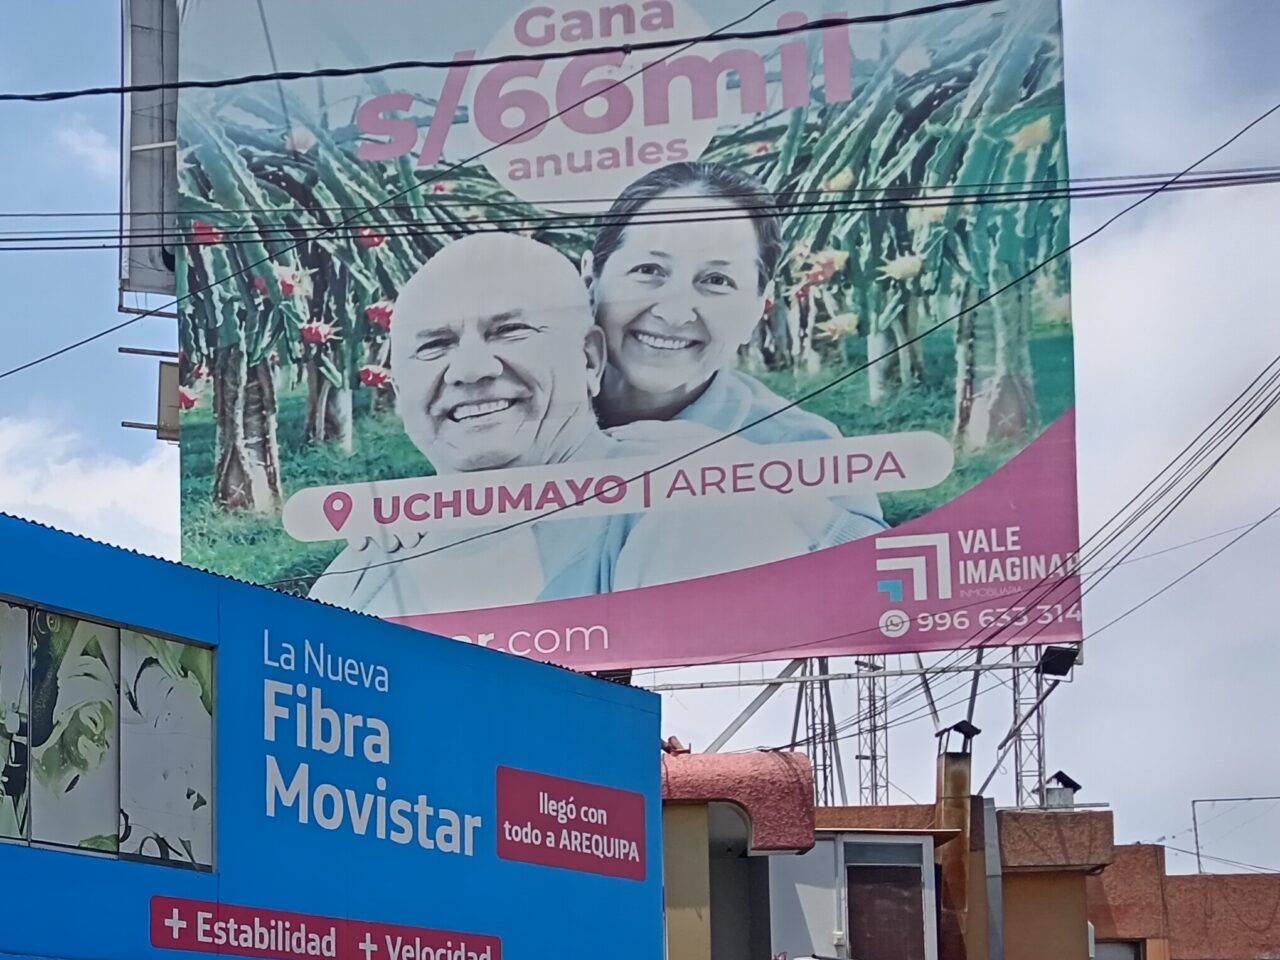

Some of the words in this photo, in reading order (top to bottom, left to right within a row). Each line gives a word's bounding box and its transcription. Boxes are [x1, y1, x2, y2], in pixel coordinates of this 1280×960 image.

[514, 0, 674, 47] Gana
[508, 132, 689, 181] anuales
[373, 474, 628, 526] UCHUMAYO
[666, 450, 906, 500] AREQUIPA
[958, 526, 1021, 554] VALE
[917, 609, 970, 632] 996
[978, 606, 1028, 628] 633
[1037, 602, 1082, 625] 314
[264, 628, 296, 671] La
[304, 638, 389, 693] Nueva
[263, 678, 390, 765] Fibra
[265, 754, 482, 858] Movistar
[538, 791, 575, 824] llegó
[580, 802, 608, 826] con
[503, 820, 542, 847] todo
[546, 830, 556, 849] a
[559, 829, 640, 863] AREQUIPA
[196, 911, 336, 958] Estabilidad
